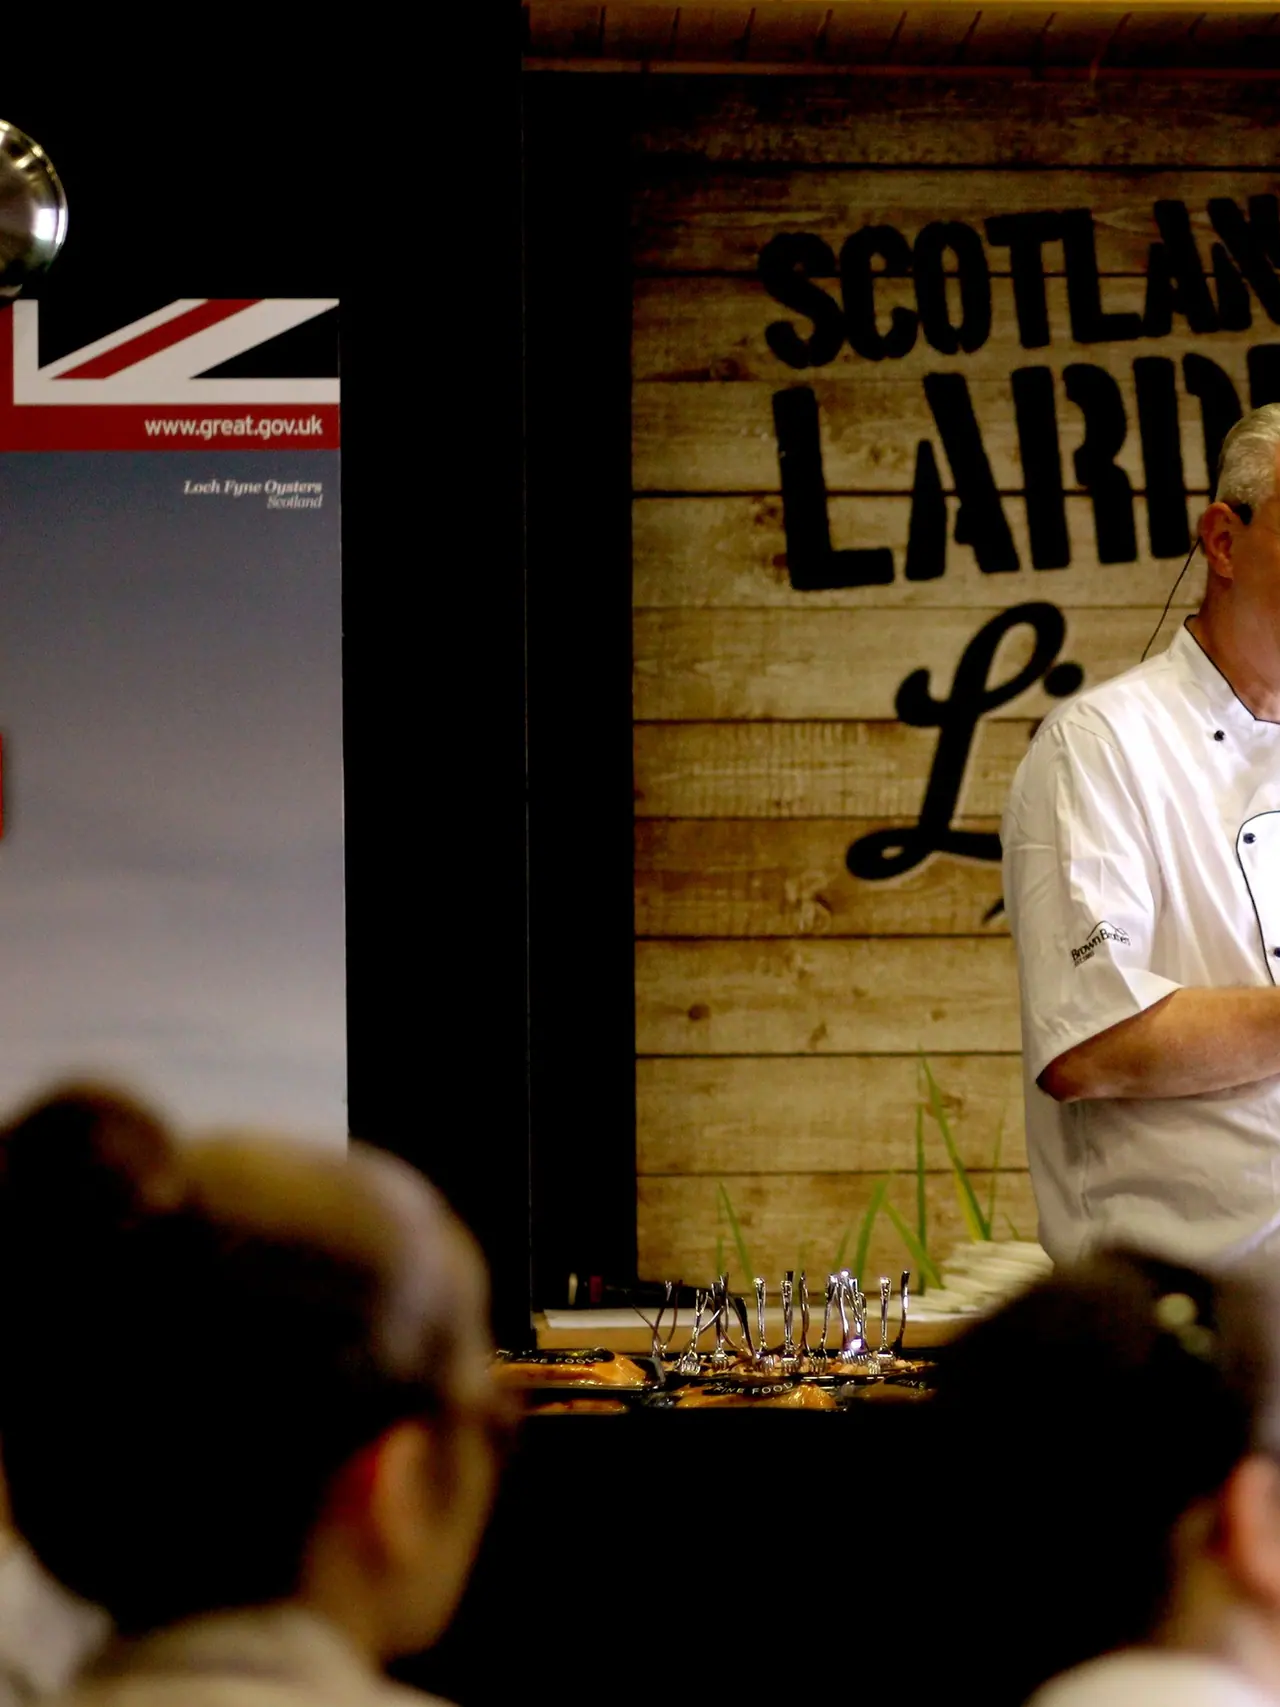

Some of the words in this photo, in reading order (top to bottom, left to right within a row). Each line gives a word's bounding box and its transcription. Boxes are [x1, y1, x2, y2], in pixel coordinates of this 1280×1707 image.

[144, 414, 323, 440] www.great.gov.uk
[184, 480, 220, 495] Loch
[224, 480, 261, 498] Fyne
[264, 479, 322, 496] Oysters
[267, 495, 323, 509] Scotland
